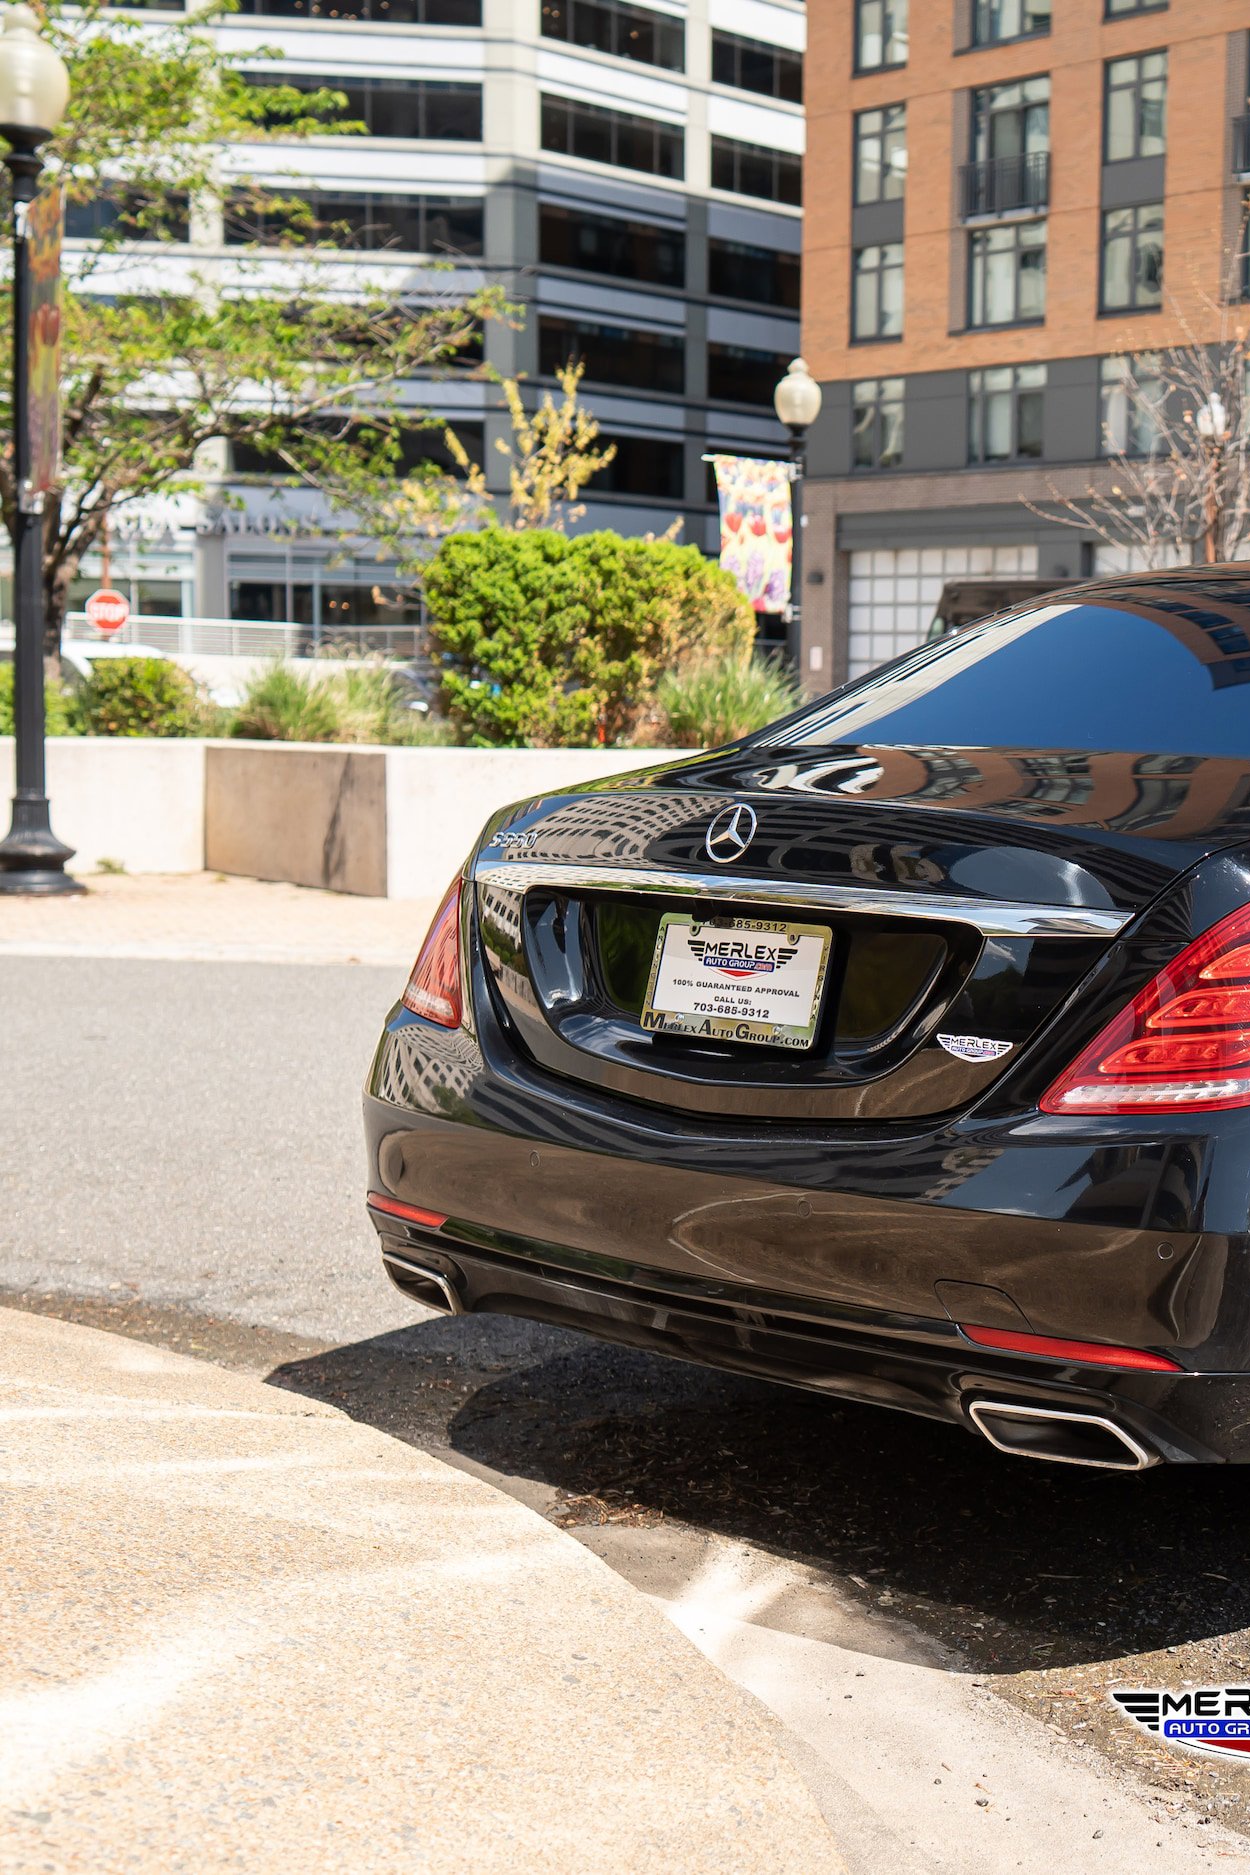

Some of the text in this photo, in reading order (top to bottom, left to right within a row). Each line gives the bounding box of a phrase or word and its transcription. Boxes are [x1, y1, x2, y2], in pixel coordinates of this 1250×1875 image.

[91, 602, 125, 621] STOP
[704, 942, 777, 961] MERLEX
[705, 957, 728, 966] AUTO
[672, 979, 800, 998] 100% GUARANTEED APPROVAL
[714, 995, 752, 1006] CALL US:
[693, 1002, 770, 1019] 703-685-9312
[951, 1037, 996, 1050] MERLEX
